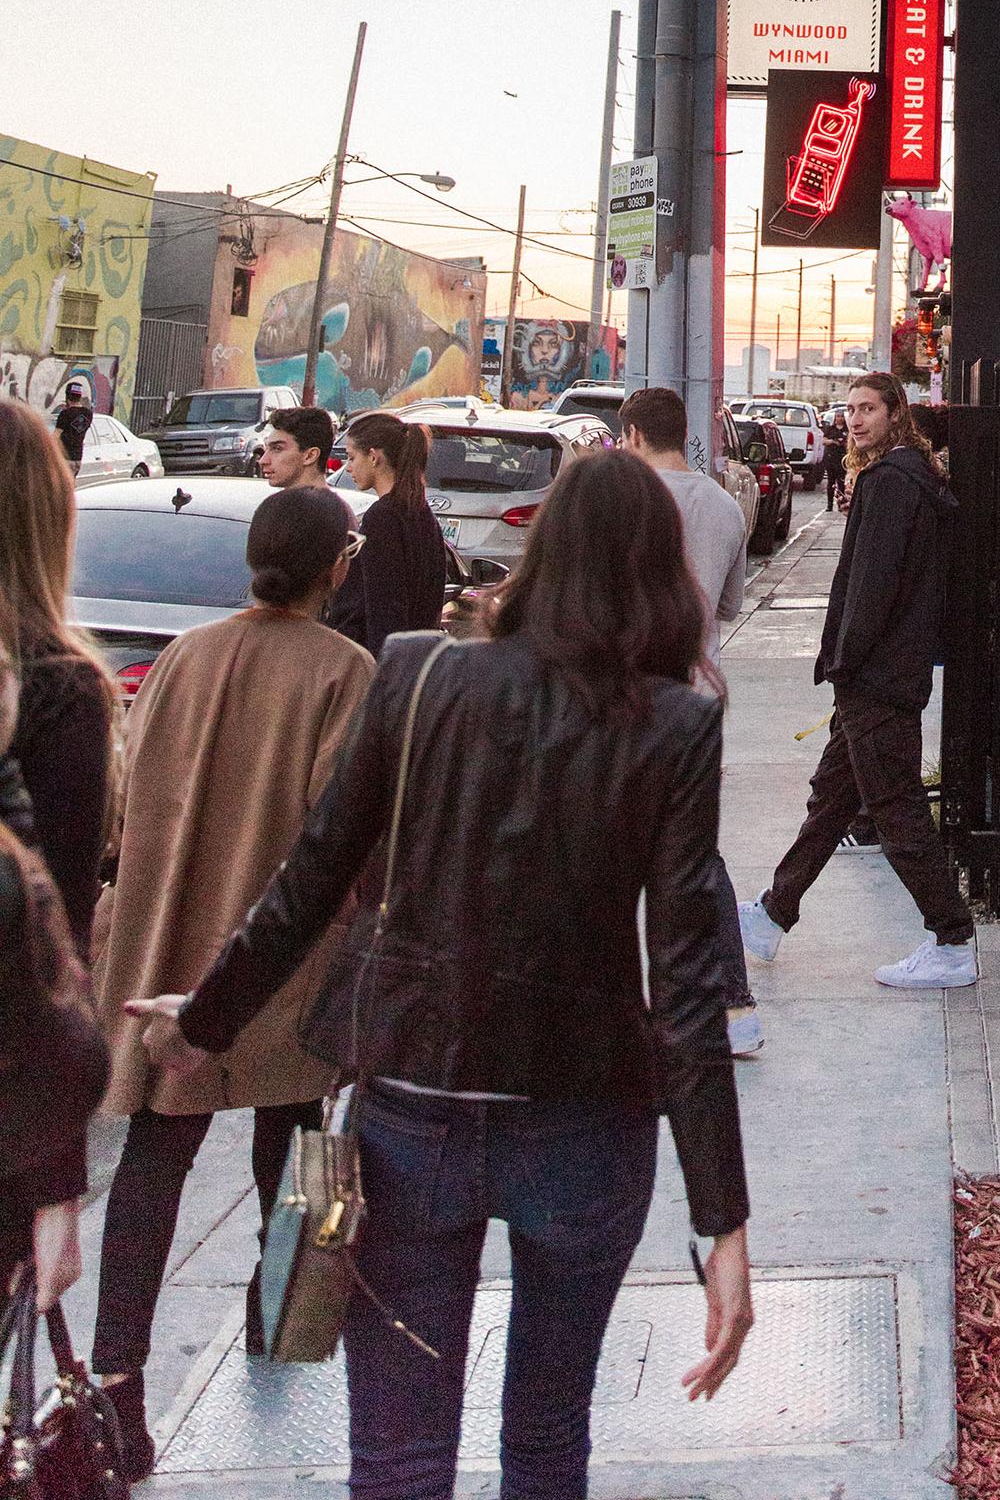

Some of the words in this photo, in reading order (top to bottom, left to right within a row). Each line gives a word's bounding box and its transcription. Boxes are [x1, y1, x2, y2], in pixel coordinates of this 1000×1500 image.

[753, 22, 848, 40] WYNWOOD
[768, 49, 829, 65] MIAMI
[905, 49, 926, 65] &
[902, 76, 926, 160] DRINK
[630, 177, 654, 193] phone
